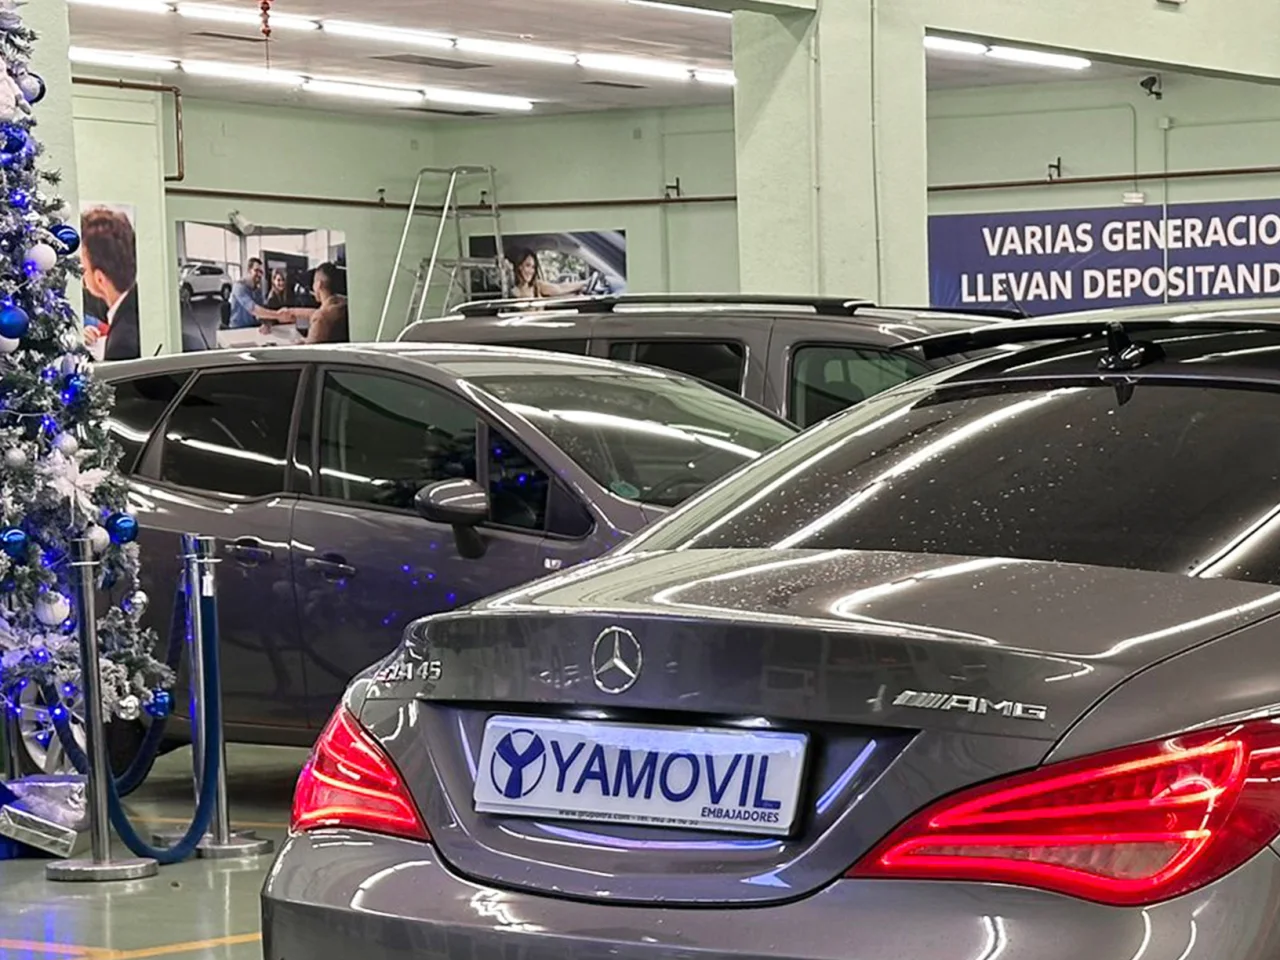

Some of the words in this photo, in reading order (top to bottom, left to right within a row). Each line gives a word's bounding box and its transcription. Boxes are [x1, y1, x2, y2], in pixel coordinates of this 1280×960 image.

[982, 222, 1093, 257] VARIAS
[961, 270, 1072, 303] LLEVAN
[416, 660, 442, 680] 45
[947, 694, 1047, 720] AMG
[551, 740, 782, 808] YAMOVIL
[700, 805, 780, 824] EMBAJADORES
